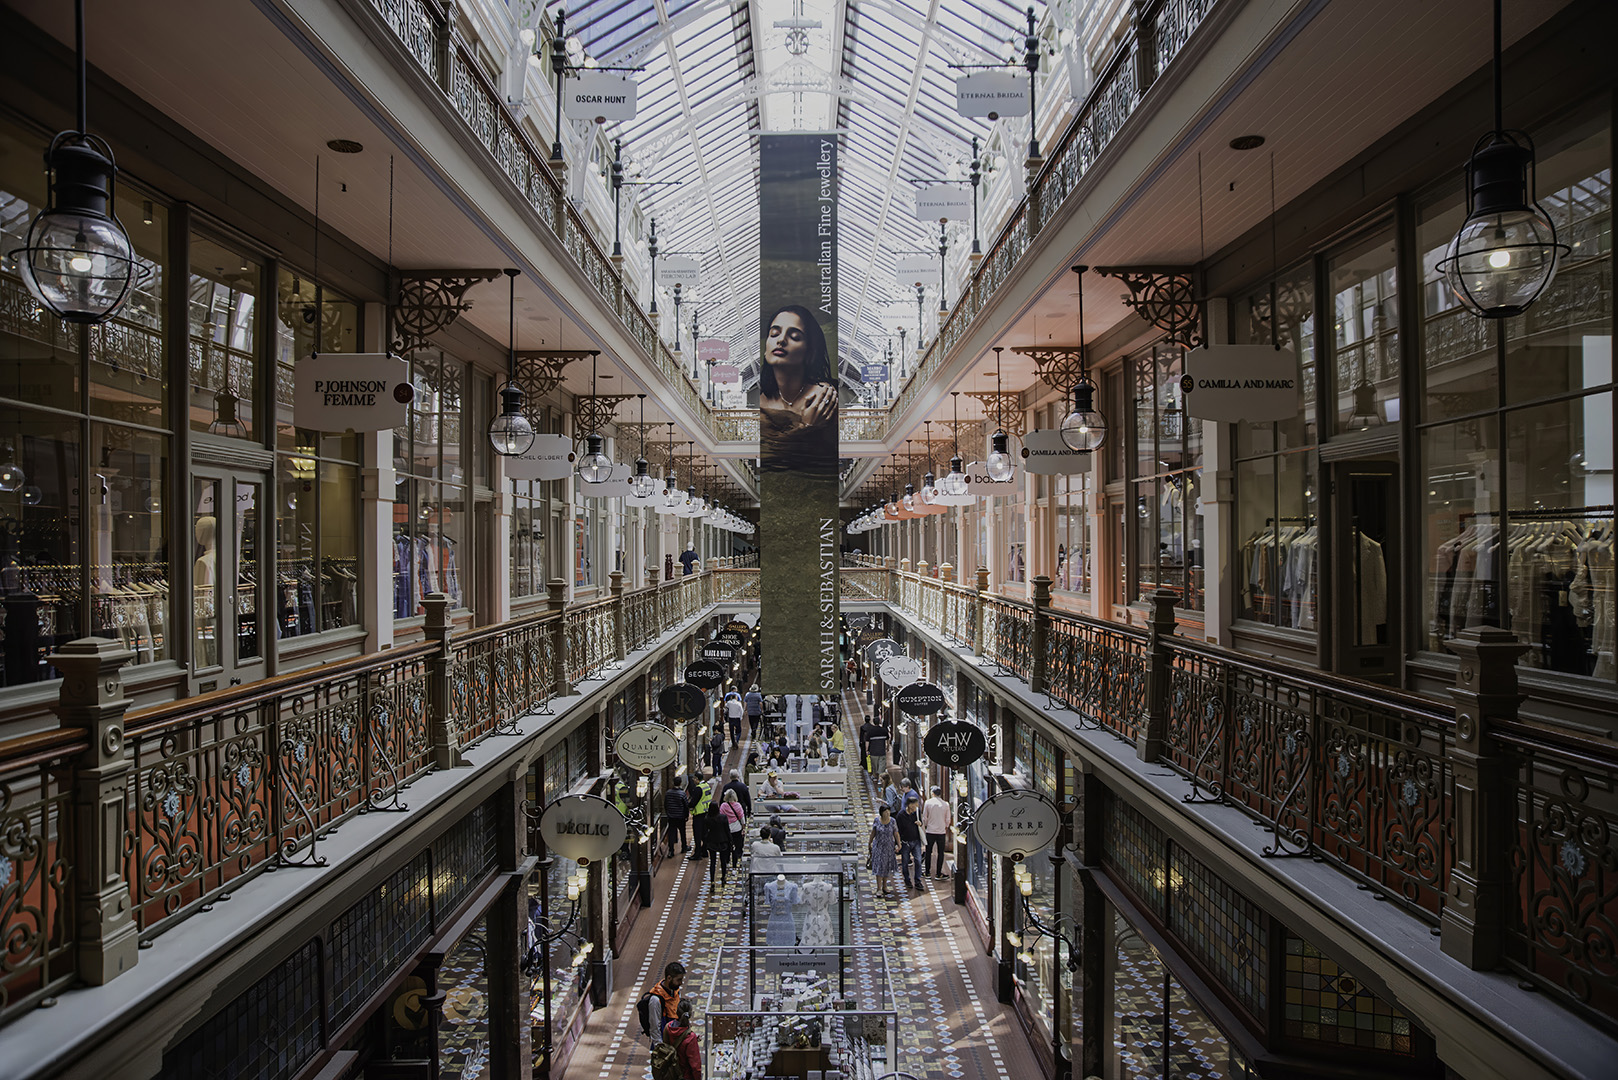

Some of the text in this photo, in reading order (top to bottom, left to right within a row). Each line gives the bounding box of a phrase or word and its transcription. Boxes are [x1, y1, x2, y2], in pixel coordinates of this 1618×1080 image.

[575, 95, 626, 104] OSCAR HUNT
[816, 139, 834, 315] Australian Fine Jewellery
[1198, 380, 1294, 389] CAMILLA AND MARC
[323, 394, 376, 406] FEMME
[688, 670, 720, 678] SECRETS
[900, 695, 942, 704] GUMPTION
[937, 732, 972, 747] AHW
[556, 818, 610, 836] DÉCLIC
[991, 821, 1044, 831] PIERRE
